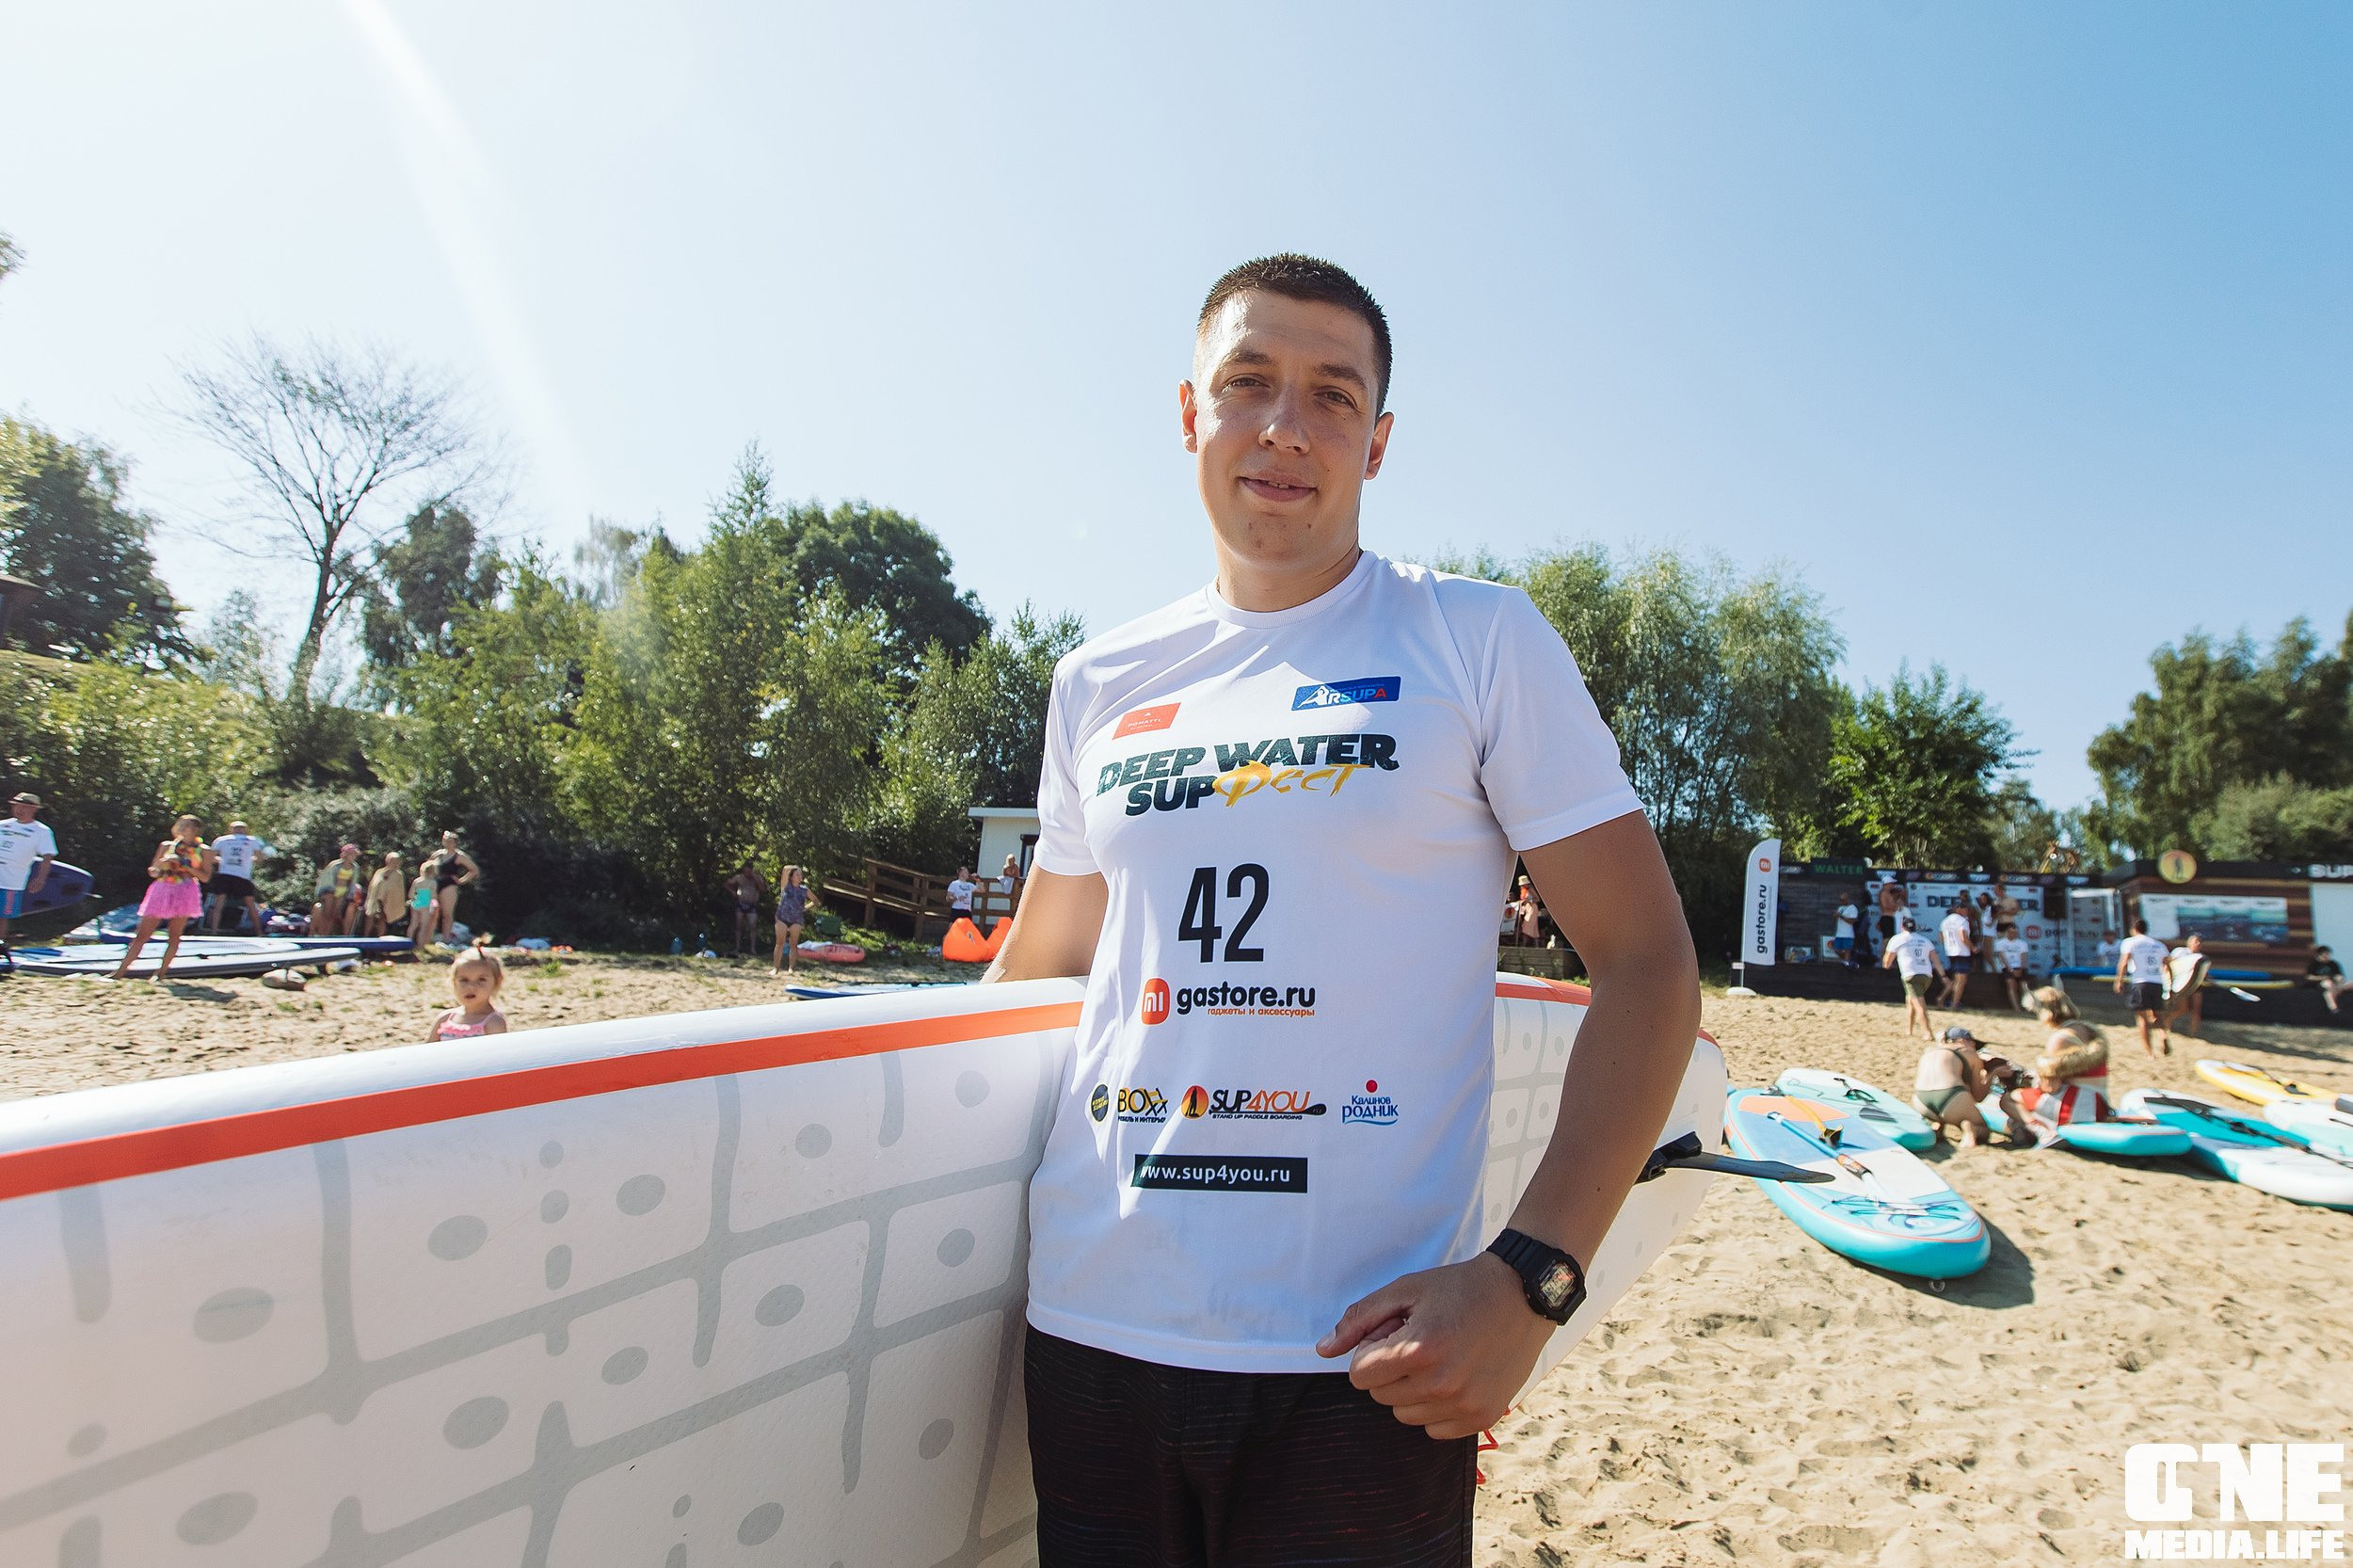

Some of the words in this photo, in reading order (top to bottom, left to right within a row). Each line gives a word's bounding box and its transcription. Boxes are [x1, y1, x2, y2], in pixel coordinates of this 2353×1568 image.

[1096, 746, 1207, 797] DEEP
[1213, 734, 1400, 772] WATER
[1178, 863, 1270, 963] 42
[1756, 885, 1768, 954] gastore.ru
[1176, 981, 1316, 1016] gastore.ru
[1208, 1008, 1246, 1016] гаджеты
[1257, 1008, 1315, 1017] аксессуары
[1210, 1089, 1311, 1112] SUP4YOU
[1352, 1095, 1392, 1105] Калинов
[1140, 1164, 1291, 1185] www.sup4you.ru
